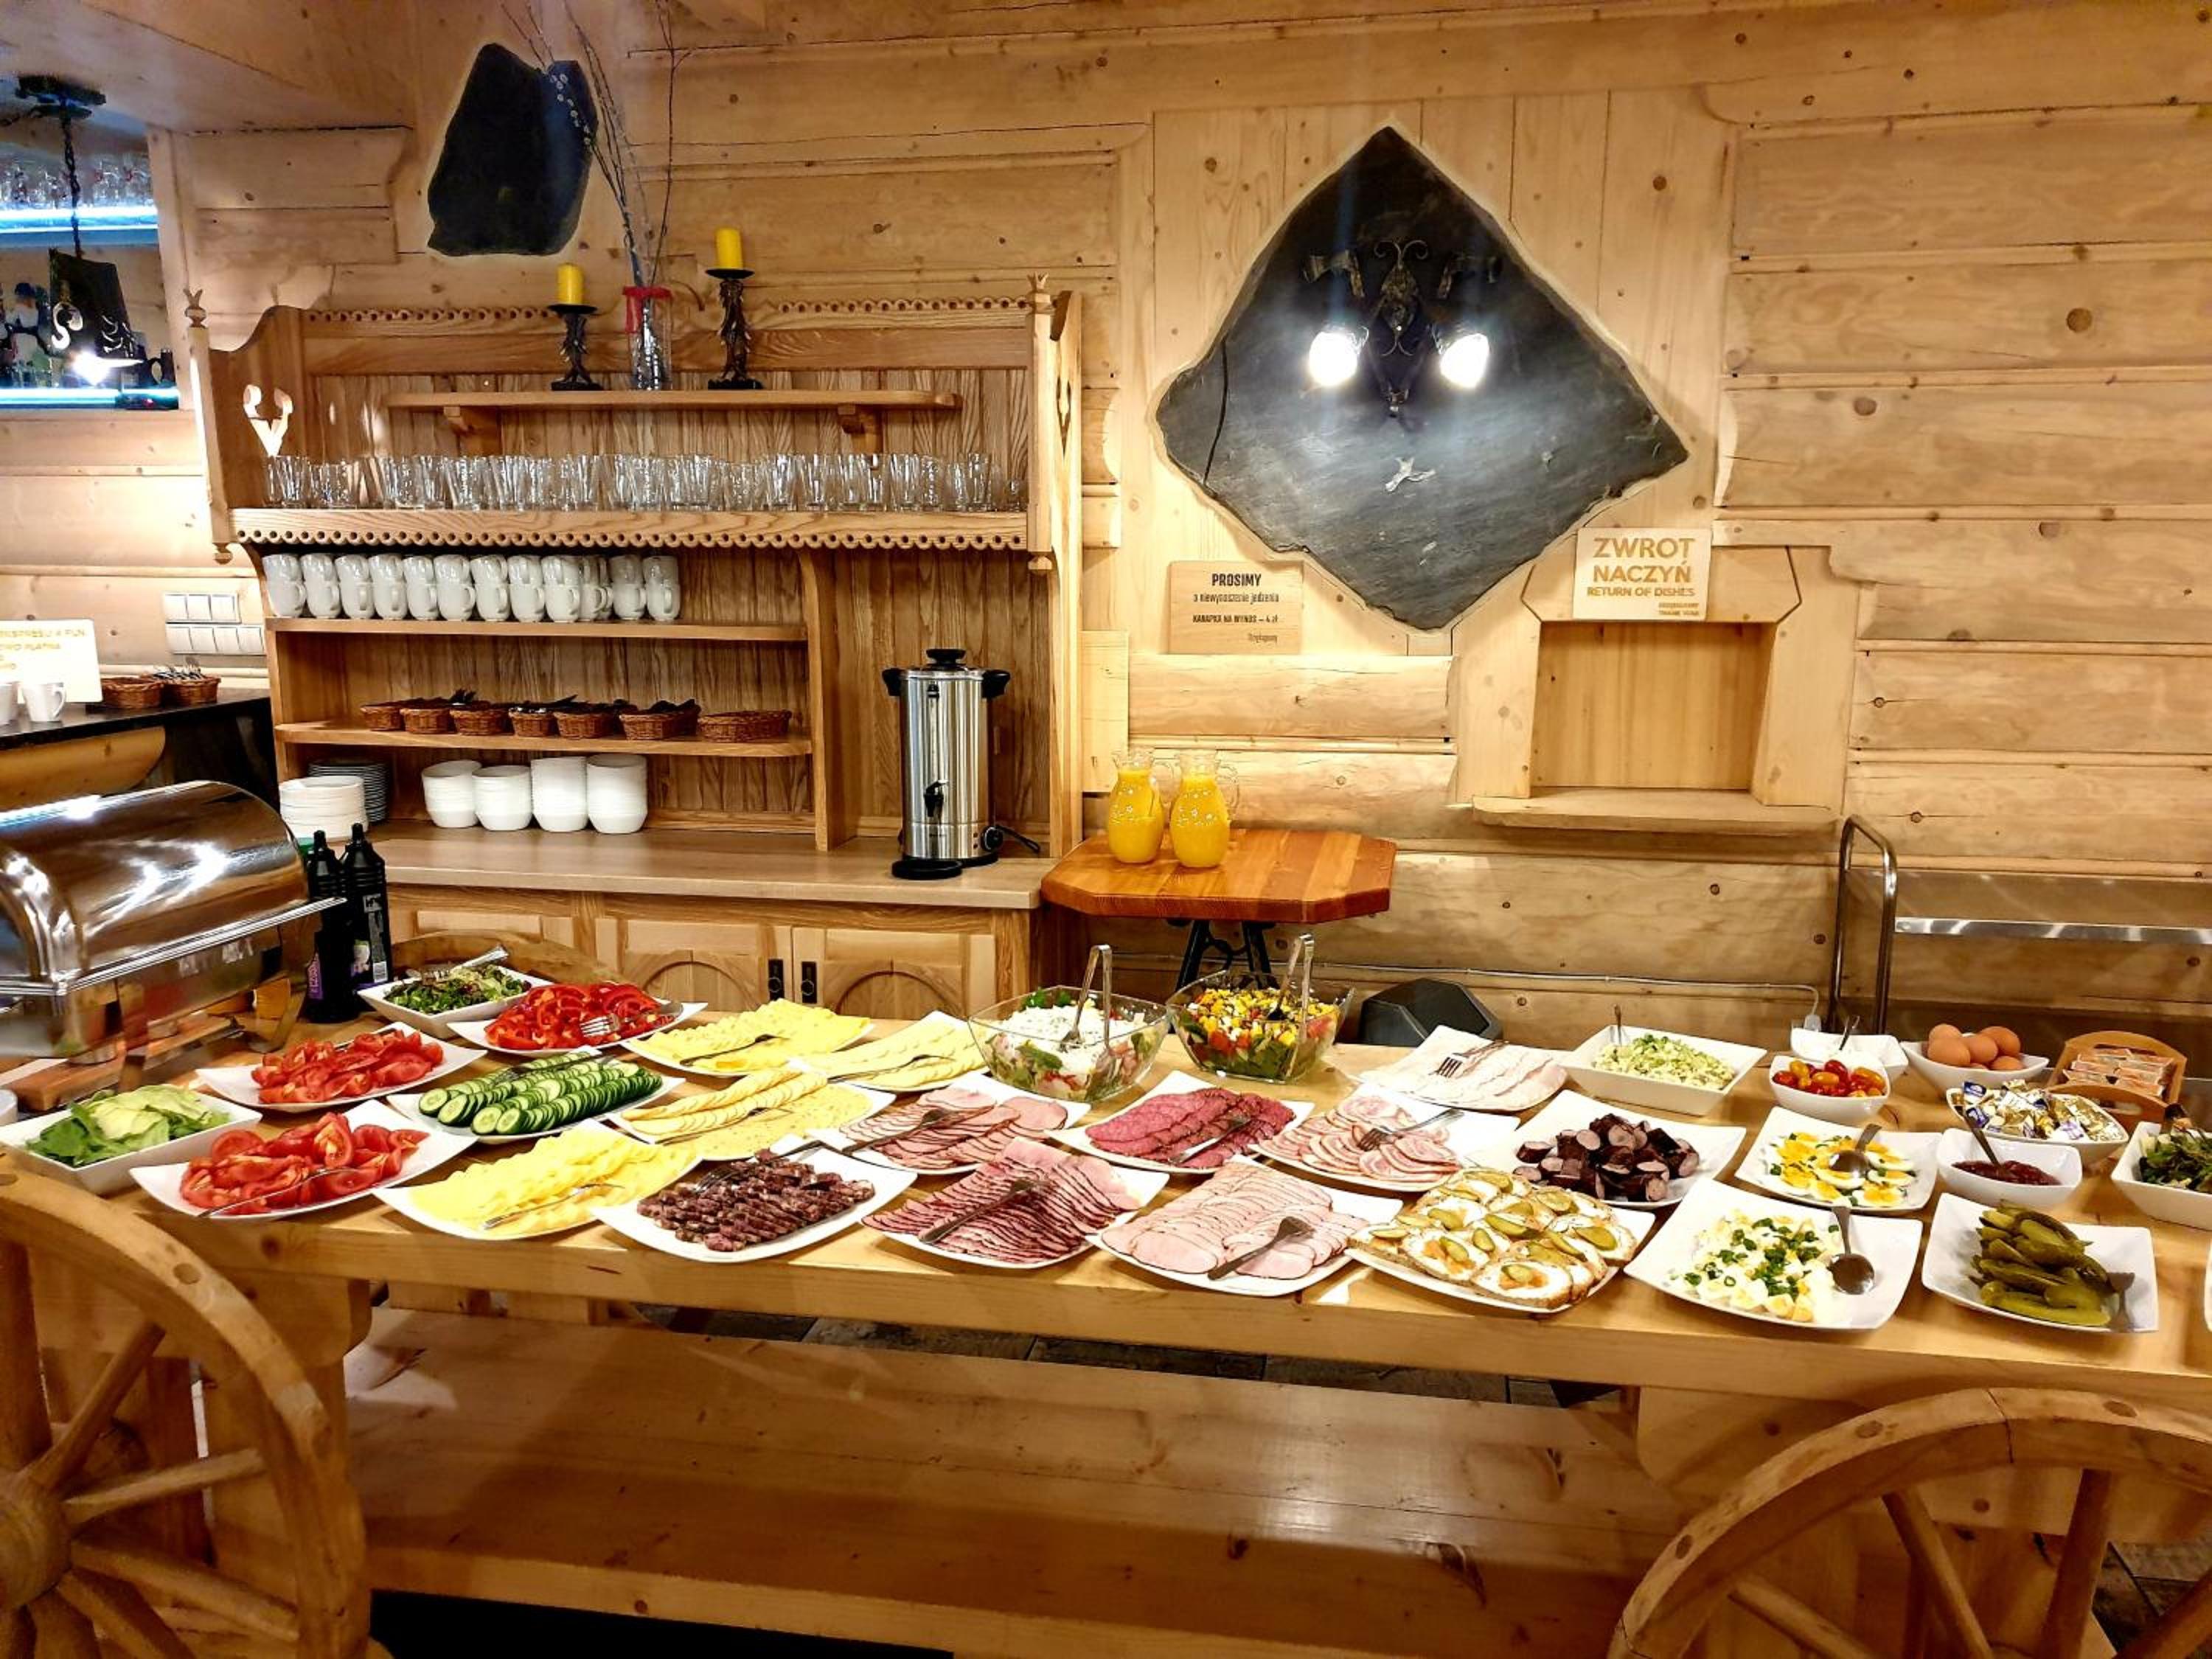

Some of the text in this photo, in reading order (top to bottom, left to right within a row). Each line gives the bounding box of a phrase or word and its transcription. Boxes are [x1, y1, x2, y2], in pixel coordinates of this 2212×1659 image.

[1593, 538, 1695, 558] ZWROT
[1593, 560, 1691, 582] NACZYŃ
[1211, 573, 1262, 586] PROSIMY
[1587, 586, 1696, 597] RETURN OF DISHES
